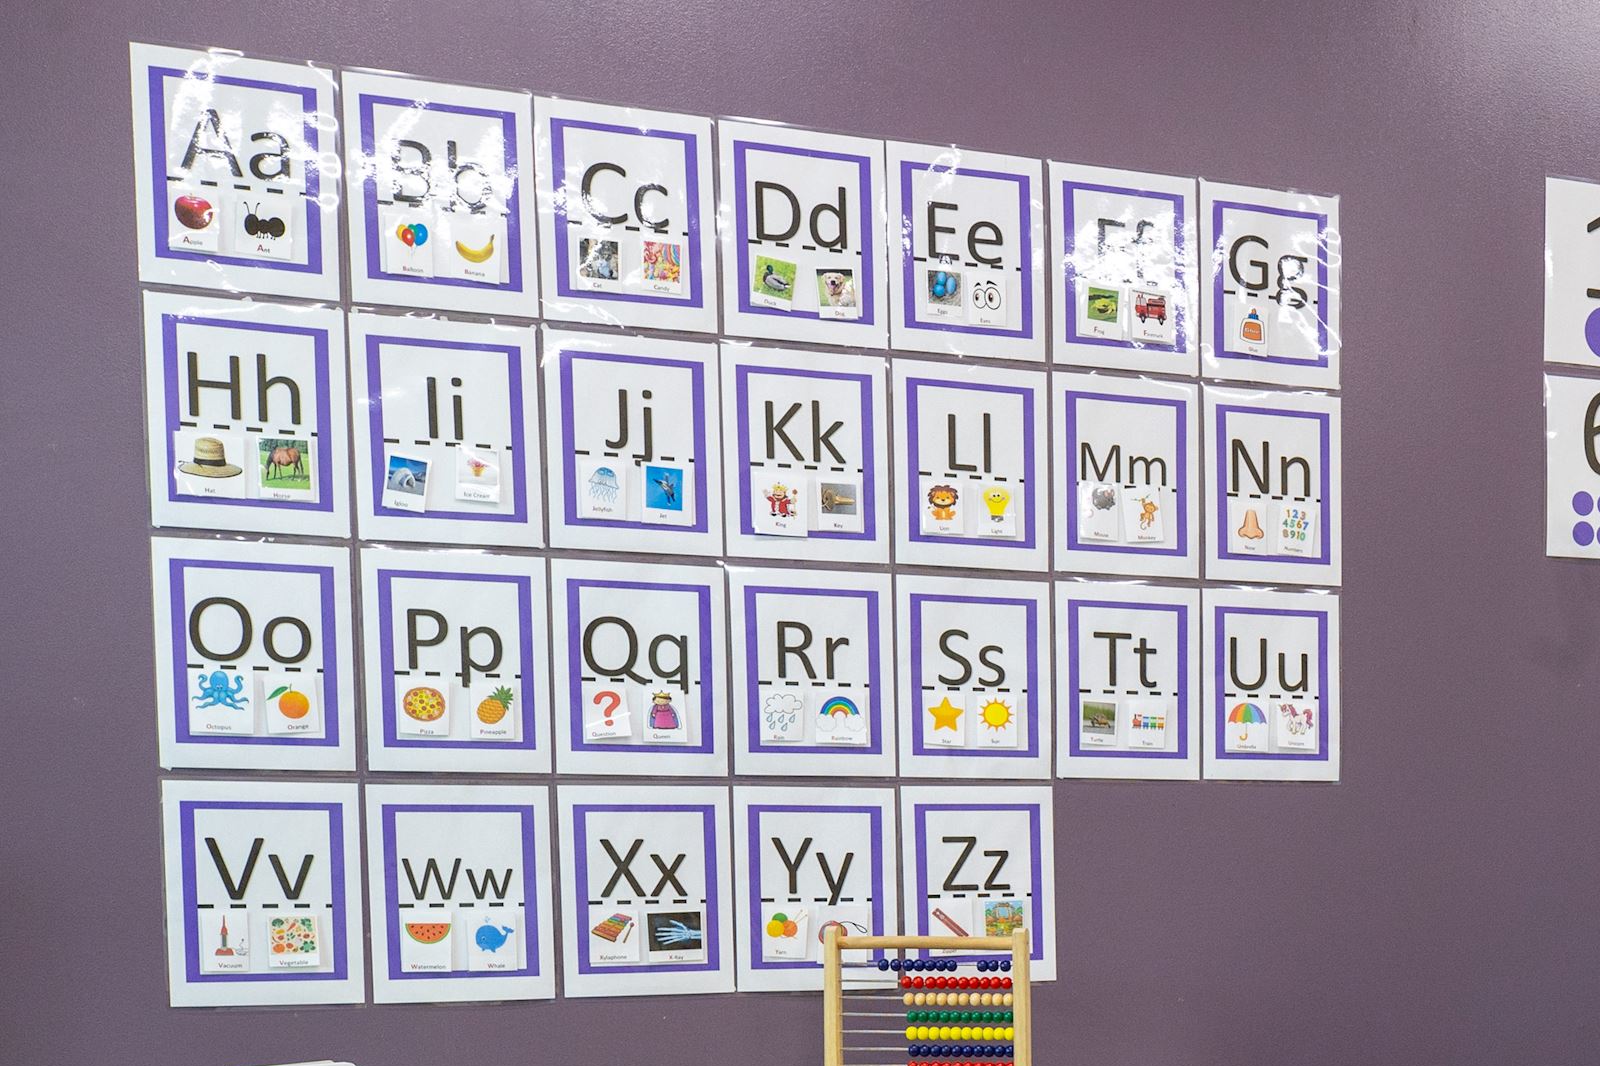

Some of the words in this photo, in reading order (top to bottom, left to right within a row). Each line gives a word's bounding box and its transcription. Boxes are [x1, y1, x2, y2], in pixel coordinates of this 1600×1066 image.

[181, 108, 291, 180] Aa
[392, 139, 492, 206] Bb
[581, 162, 669, 229] Cc
[755, 181, 847, 249] Dd
[257, 244, 270, 254] Ant
[927, 201, 1004, 266] Ee
[402, 265, 425, 274] Balloon
[464, 269, 486, 278] Banana
[653, 284, 671, 292] Candy
[1228, 235, 1308, 309] Gg
[187, 351, 301, 425] Hh
[426, 376, 464, 440] Ii
[605, 389, 652, 466] Jj
[764, 400, 846, 464] Kk
[947, 413, 992, 473] Ll
[1081, 442, 1167, 486] Mm
[1231, 438, 1311, 497] Nn
[592, 506, 613, 514] Jellyfish
[775, 521, 787, 529] King
[188, 596, 312, 664] Oo
[407, 608, 503, 688] Pp
[582, 616, 689, 694] Qq
[777, 620, 849, 680] Rr
[938, 629, 1006, 687] Ss
[1093, 631, 1157, 688] Tt
[1230, 637, 1308, 692] Uu
[206, 722, 231, 731] Octopus
[287, 723, 309, 731] Orange
[419, 728, 434, 736] Pizza
[480, 729, 507, 737] Pineapple
[204, 837, 314, 900] Vv
[401, 858, 513, 900] Ww
[599, 838, 688, 897] Xx
[771, 837, 854, 905] Yy
[941, 836, 1011, 891] Zz
[279, 959, 309, 967] Vegetable
[410, 962, 447, 970] Watermelon
